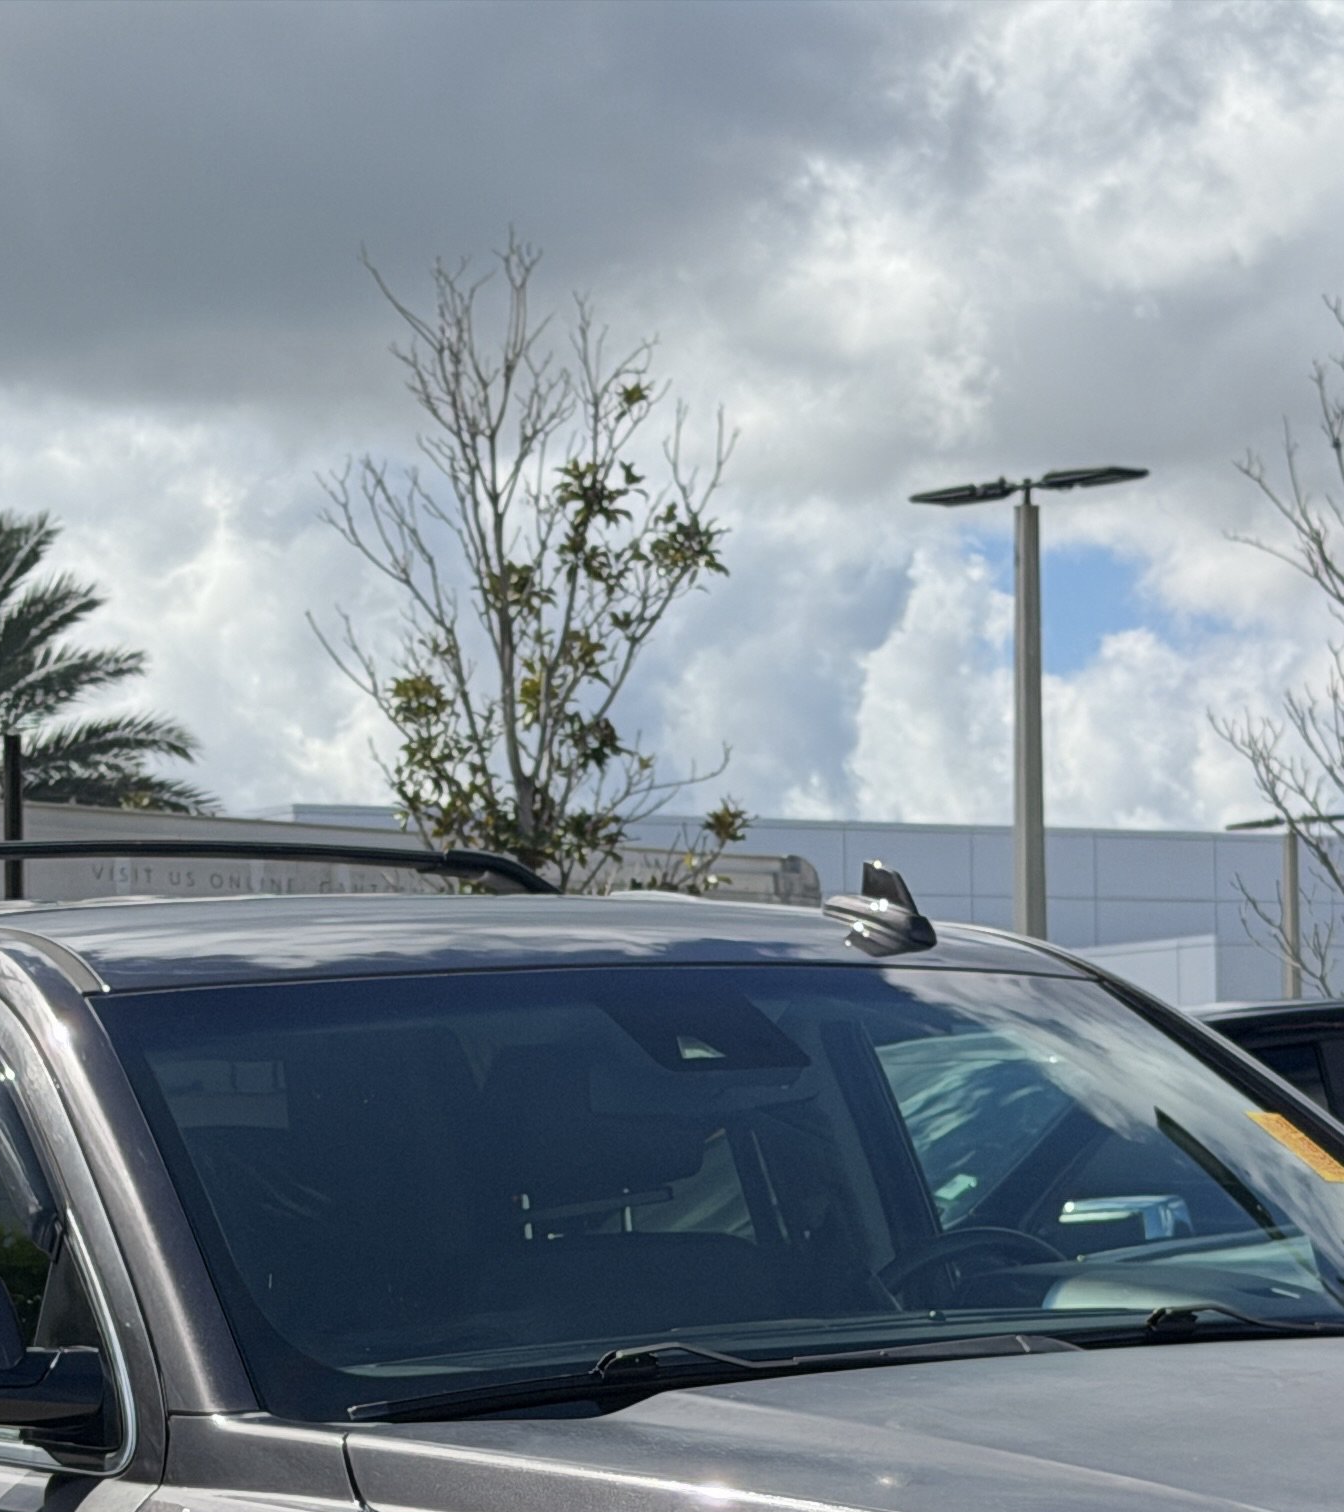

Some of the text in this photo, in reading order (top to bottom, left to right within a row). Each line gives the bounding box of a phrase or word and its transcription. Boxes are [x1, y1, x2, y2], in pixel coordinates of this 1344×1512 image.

[91, 864, 153, 886] VISIT
[168, 871, 196, 887] US
[209, 872, 295, 894] ONLINE
